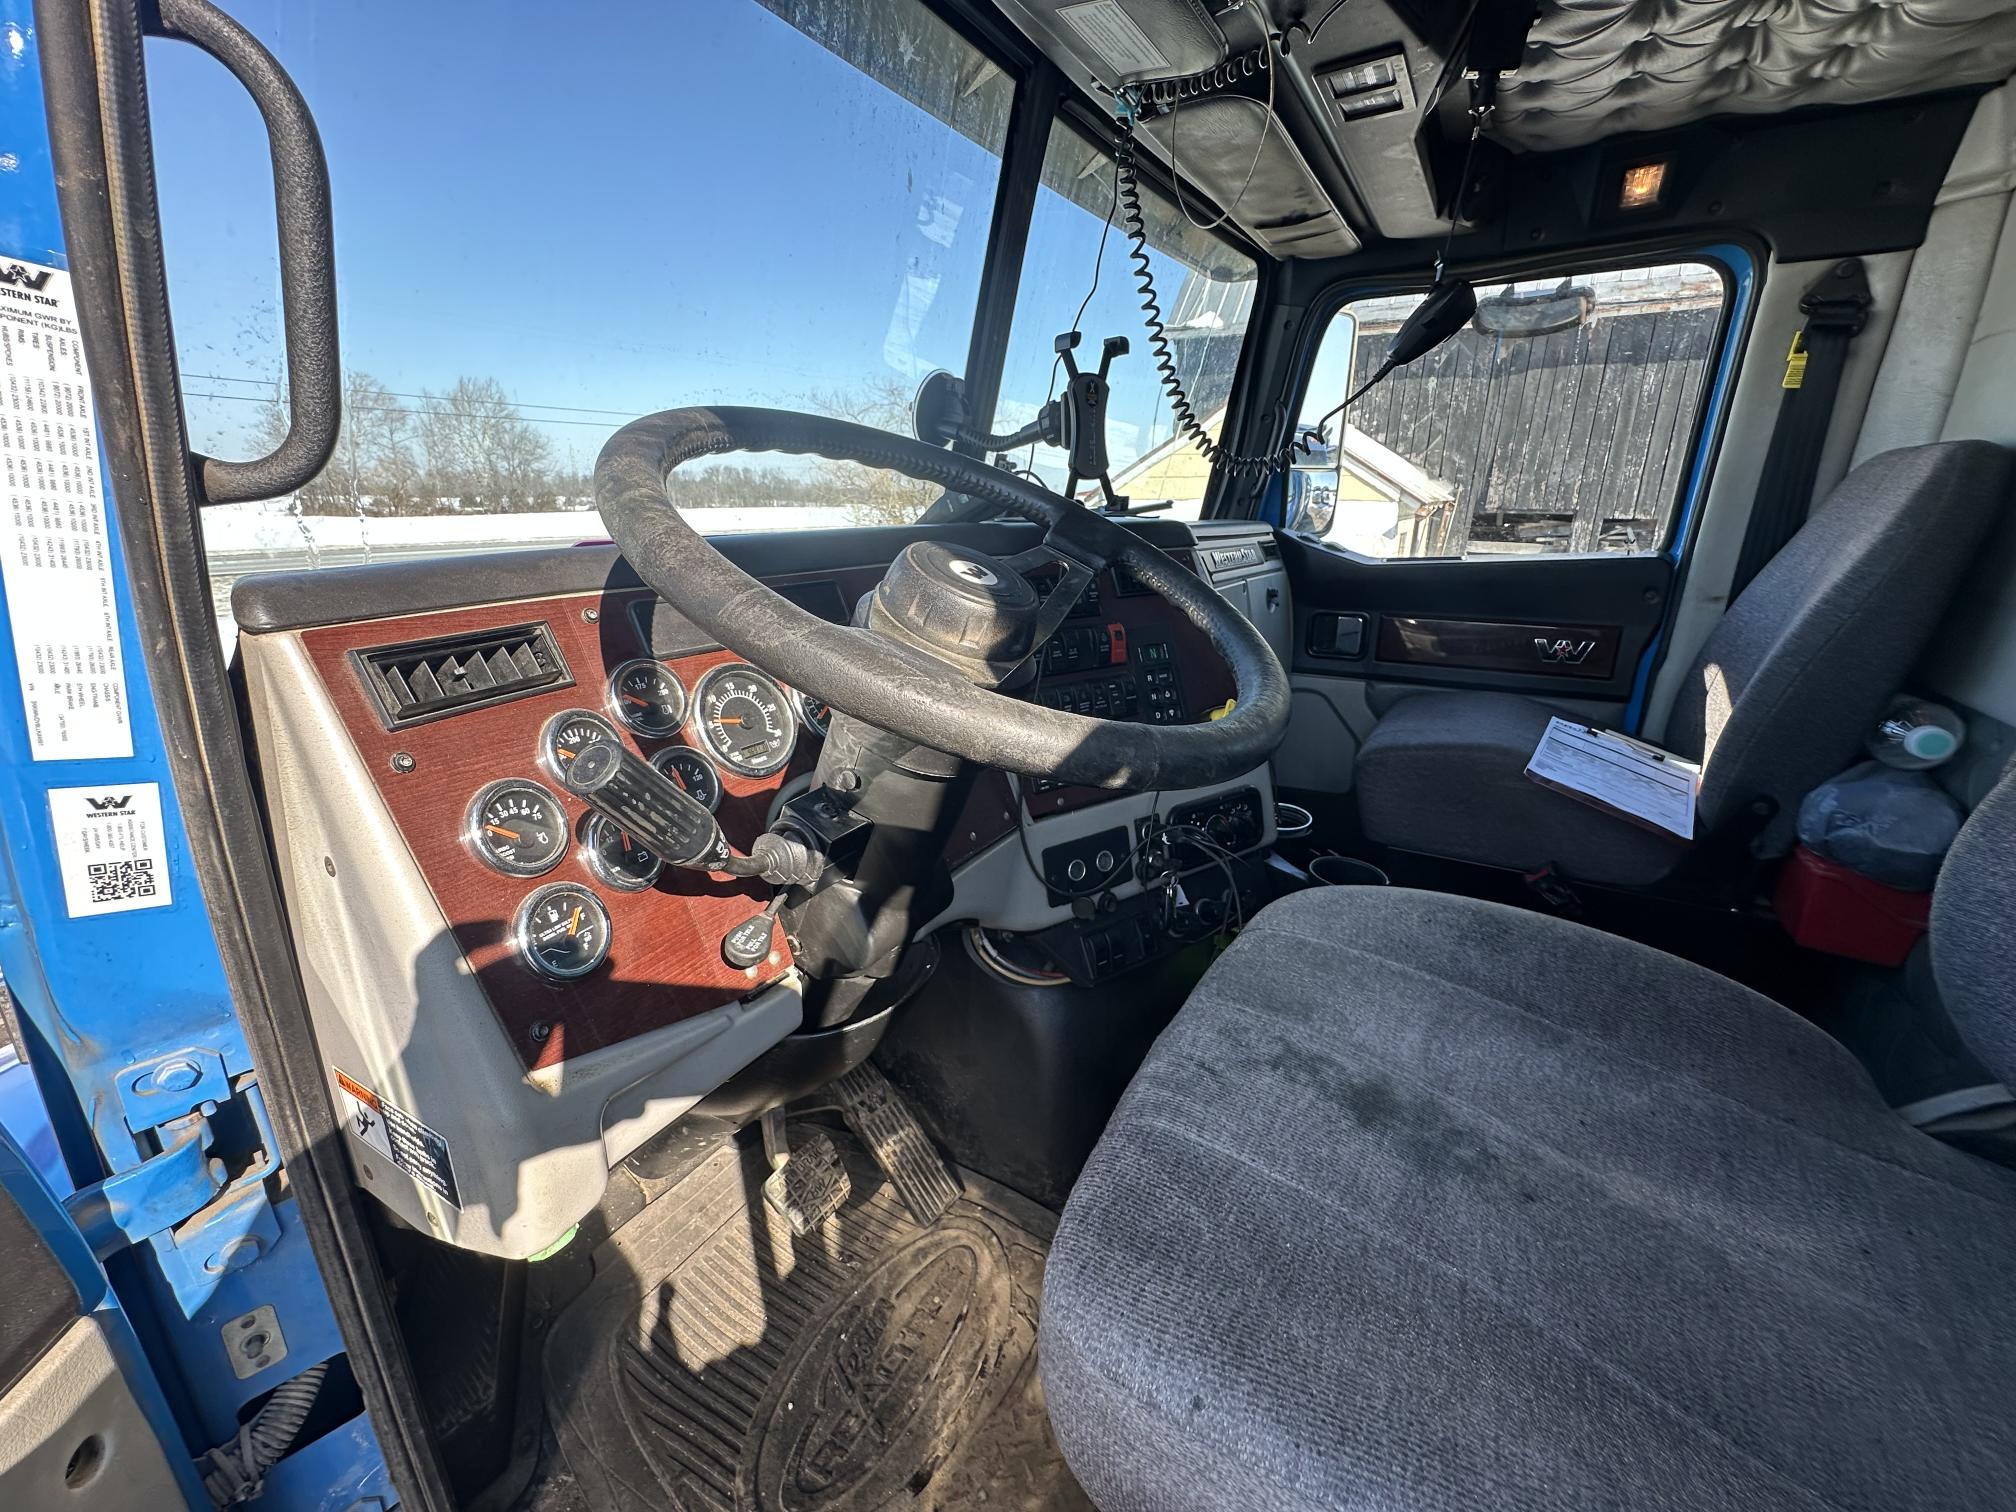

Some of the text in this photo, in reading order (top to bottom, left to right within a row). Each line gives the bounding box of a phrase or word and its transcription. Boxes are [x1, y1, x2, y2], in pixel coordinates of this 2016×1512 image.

[0, 288, 58, 307] STERN STAR
[34, 313, 57, 322] GWR
[725, 682, 735, 690] 15
[499, 810, 509, 818] 30
[509, 807, 519, 815] 45
[520, 807, 531, 816] 60
[531, 812, 543, 821] 75
[490, 817, 500, 826] 15
[731, 930, 742, 944] PUSH
[746, 938, 757, 950] PULL
